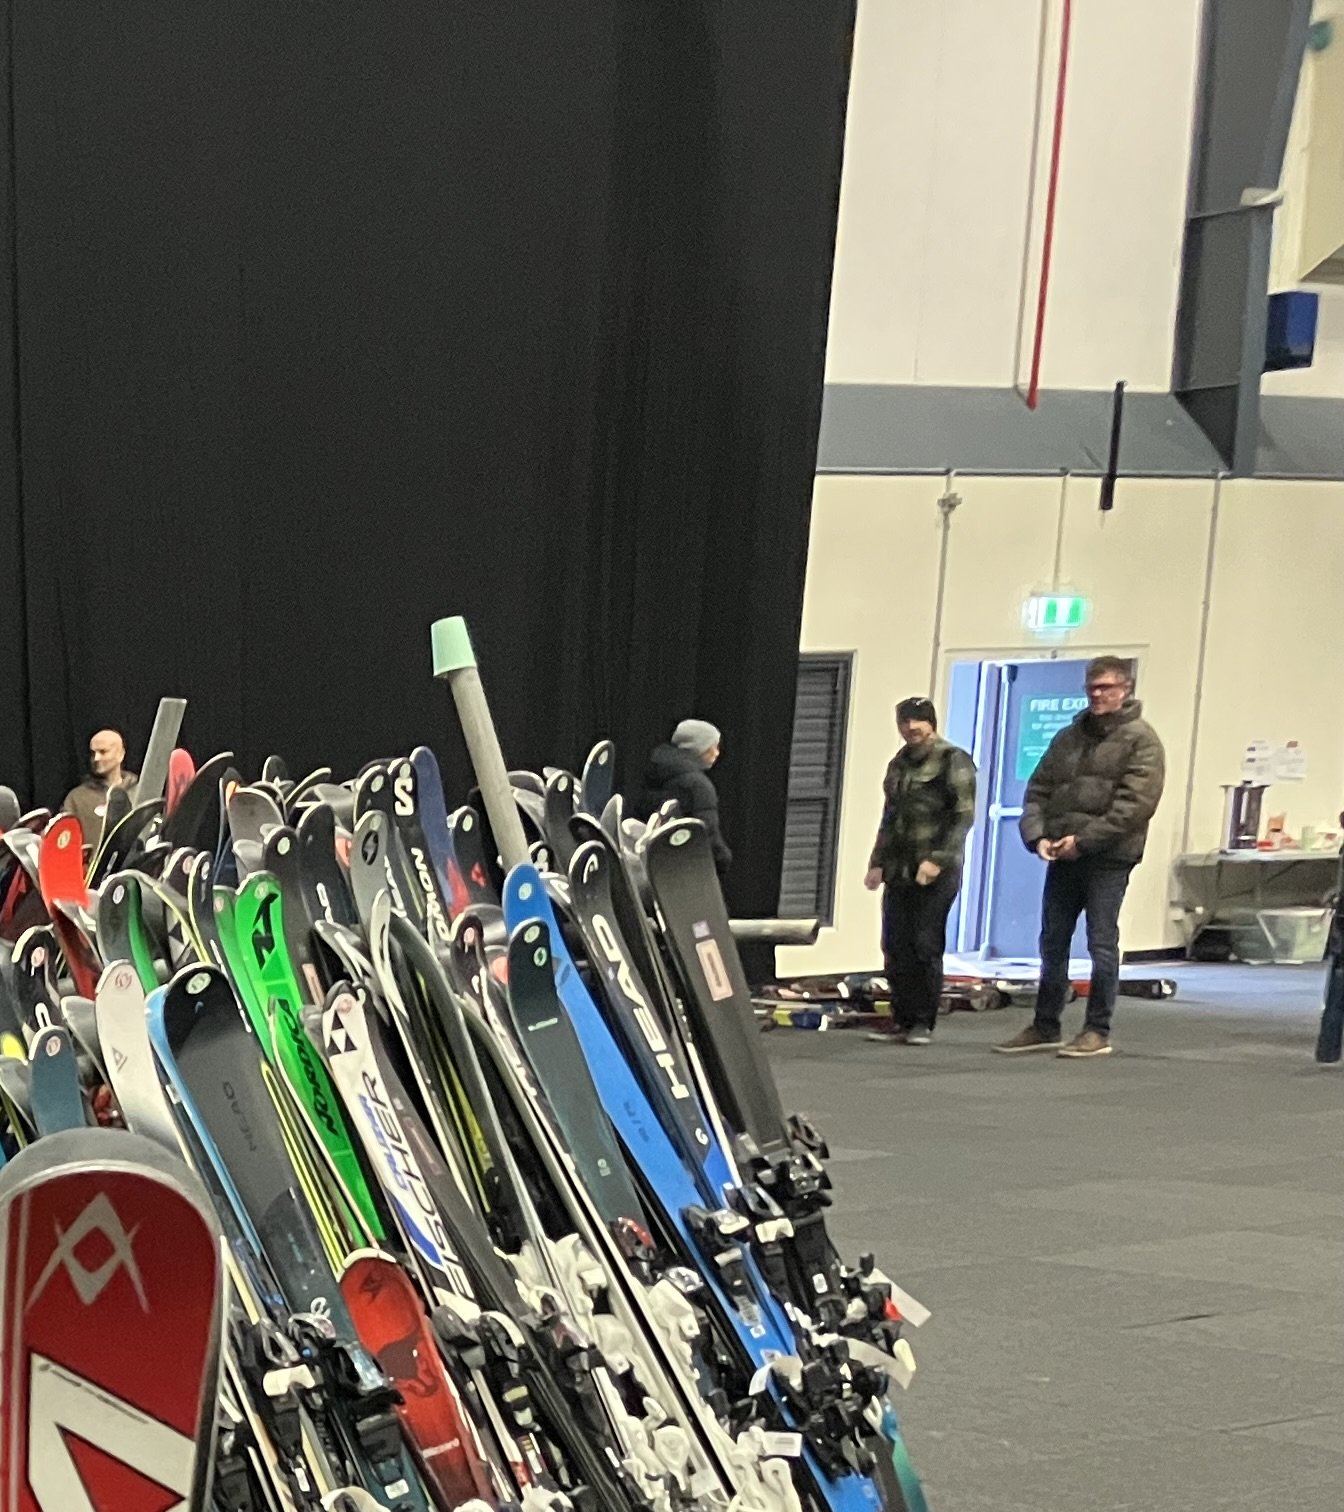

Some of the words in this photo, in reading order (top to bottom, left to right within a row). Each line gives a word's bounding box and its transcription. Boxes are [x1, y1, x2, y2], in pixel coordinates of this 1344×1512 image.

[1030, 698, 1060, 712] FIRE
[277, 998, 340, 1137] NORDICA
[592, 914, 690, 1100] HEAD
[362, 1071, 475, 1300] FISCHER
